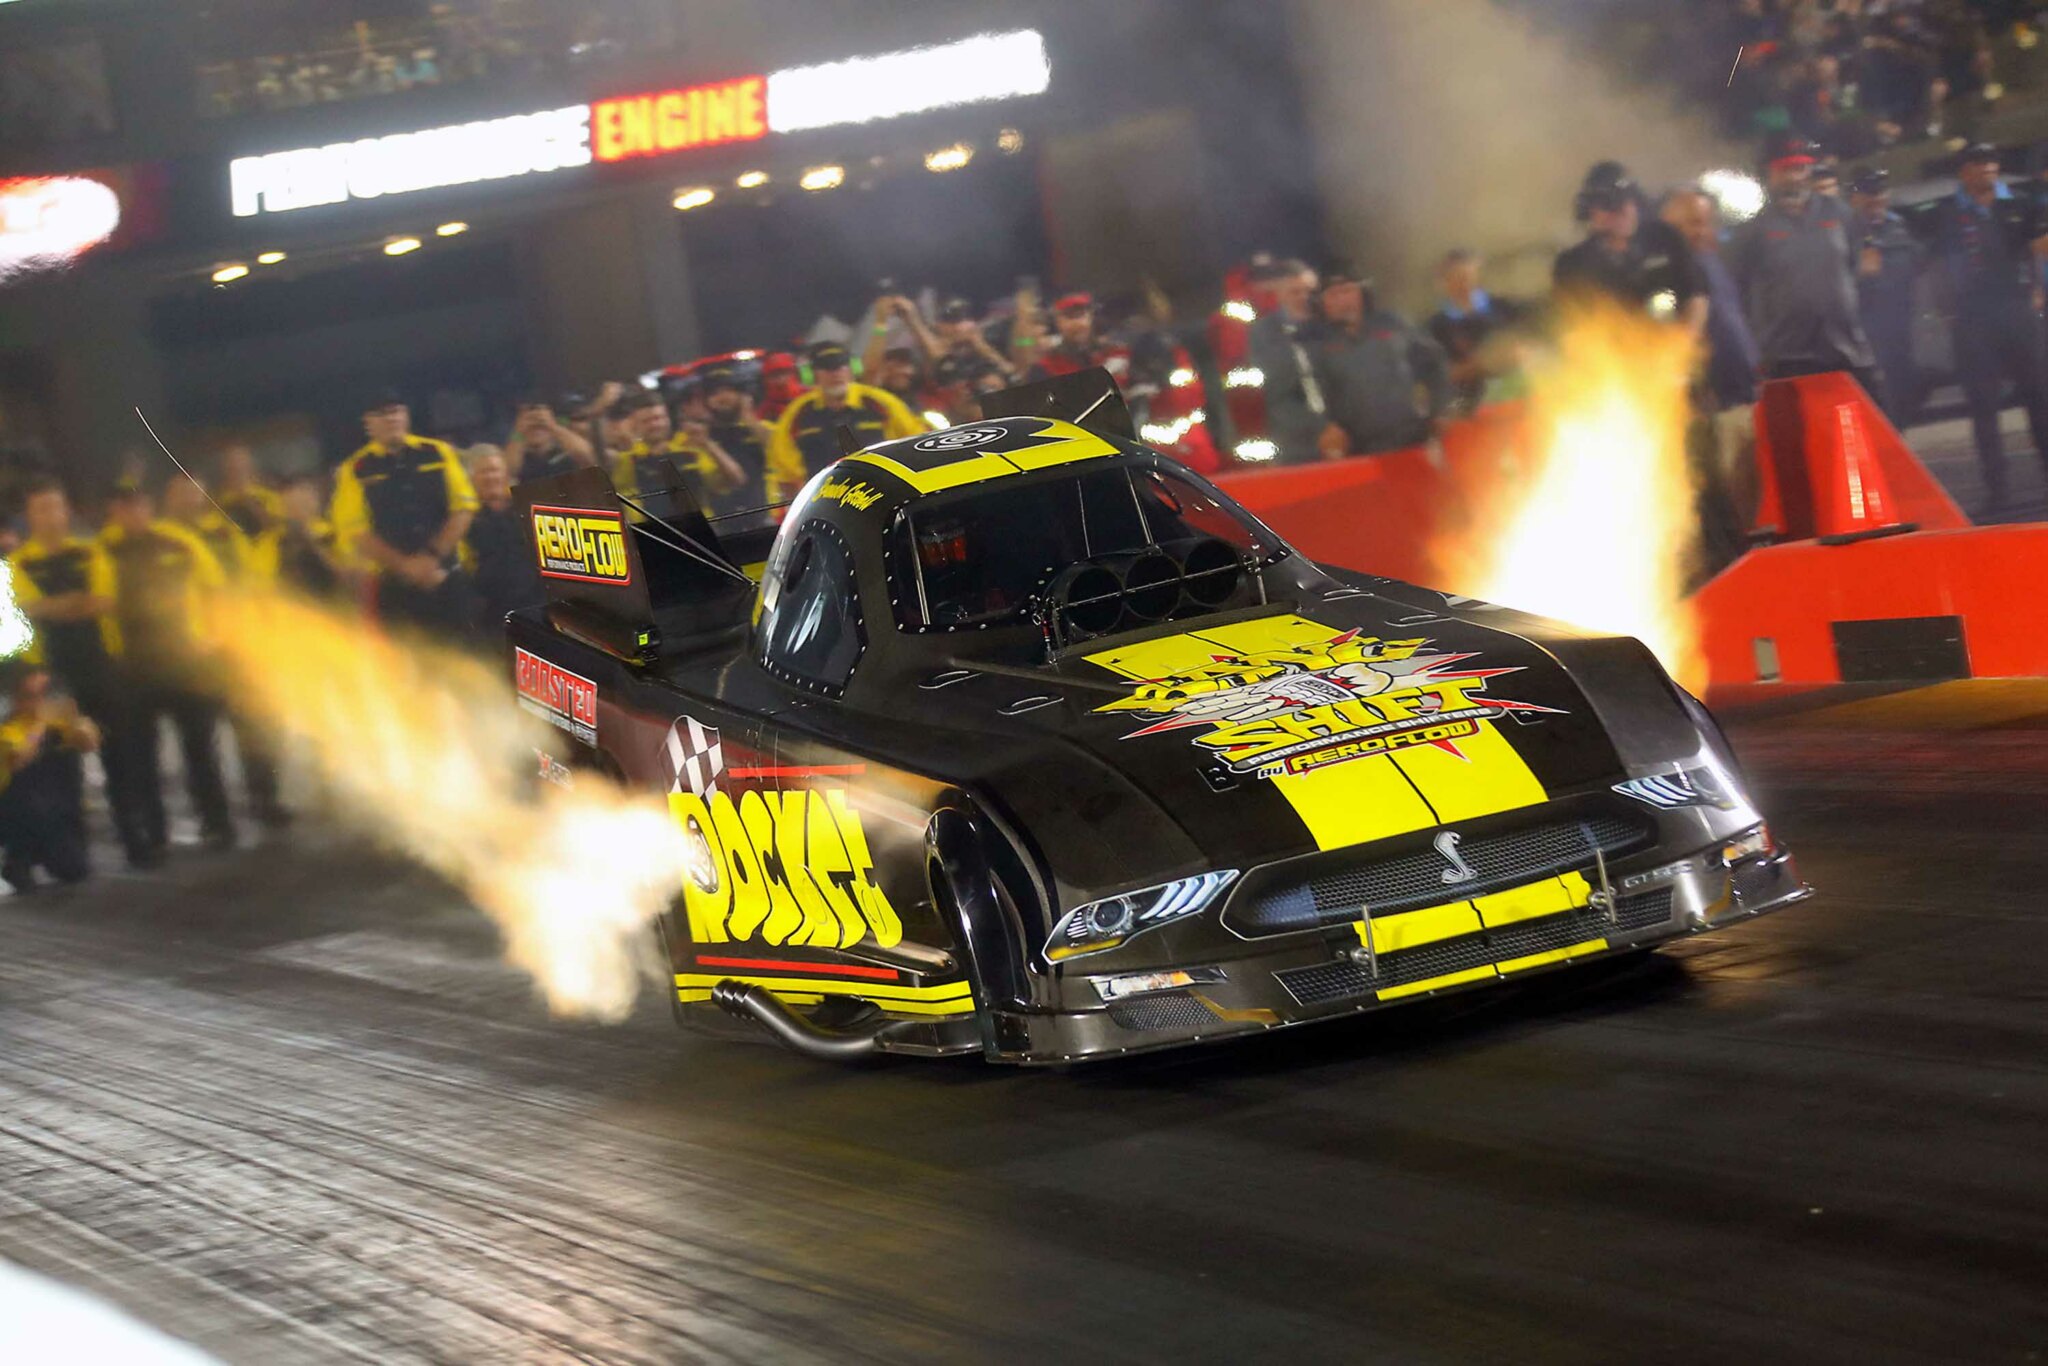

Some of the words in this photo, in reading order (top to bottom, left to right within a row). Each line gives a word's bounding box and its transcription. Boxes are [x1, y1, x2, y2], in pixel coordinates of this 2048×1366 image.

[594, 74, 768, 162] ENGINE
[1196, 677, 1483, 762] SHIFT
[1248, 724, 1395, 766] PERFORMANCE
[1396, 707, 1492, 729] SHIFTERS
[1290, 721, 1474, 772] AEROFLOW
